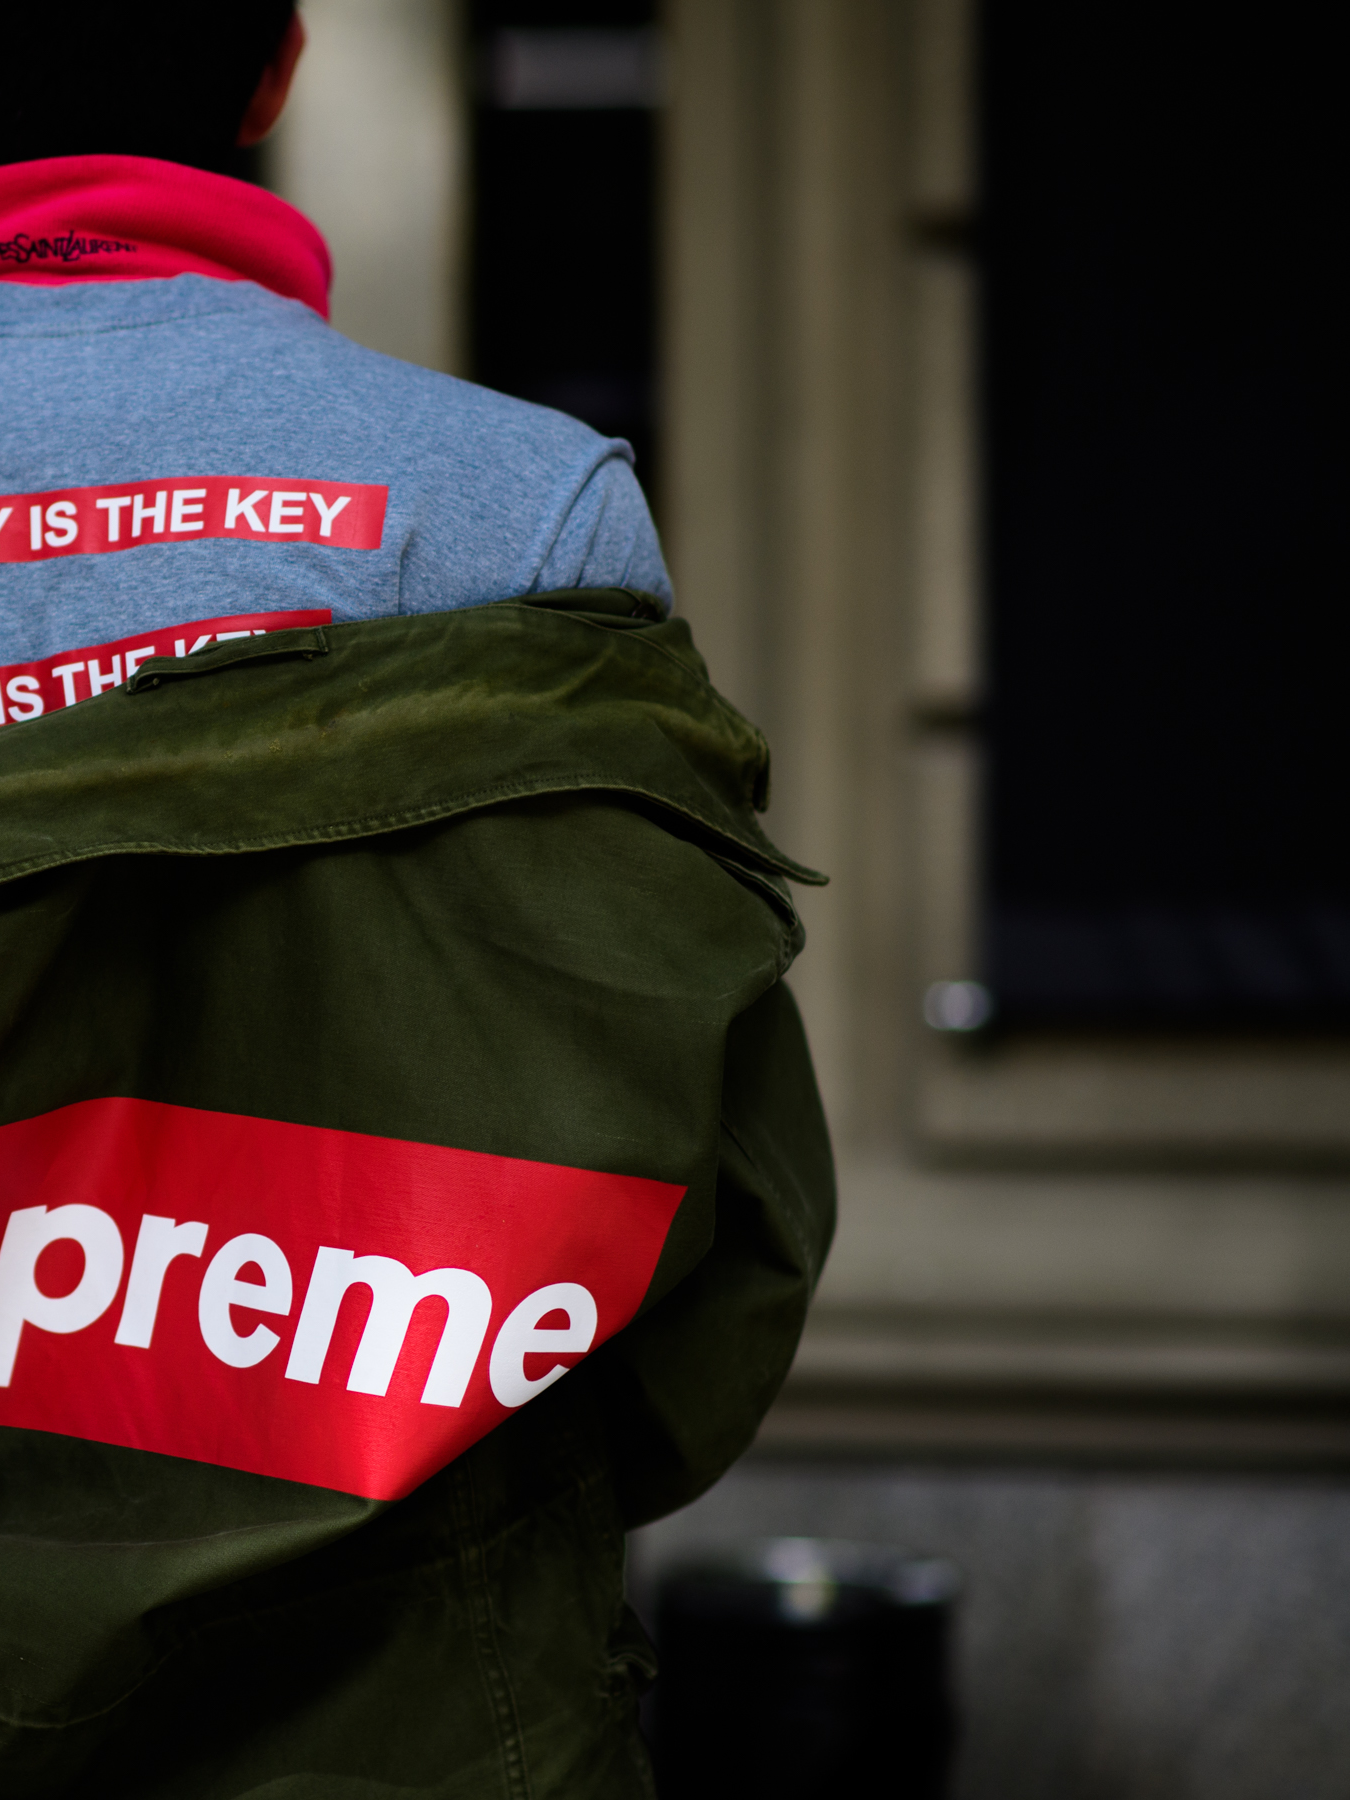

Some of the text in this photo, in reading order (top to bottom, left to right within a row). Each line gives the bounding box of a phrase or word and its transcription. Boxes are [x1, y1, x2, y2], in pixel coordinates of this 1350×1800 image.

[29, 500, 79, 551] IS
[95, 488, 207, 543] THE
[223, 488, 352, 538] KEY
